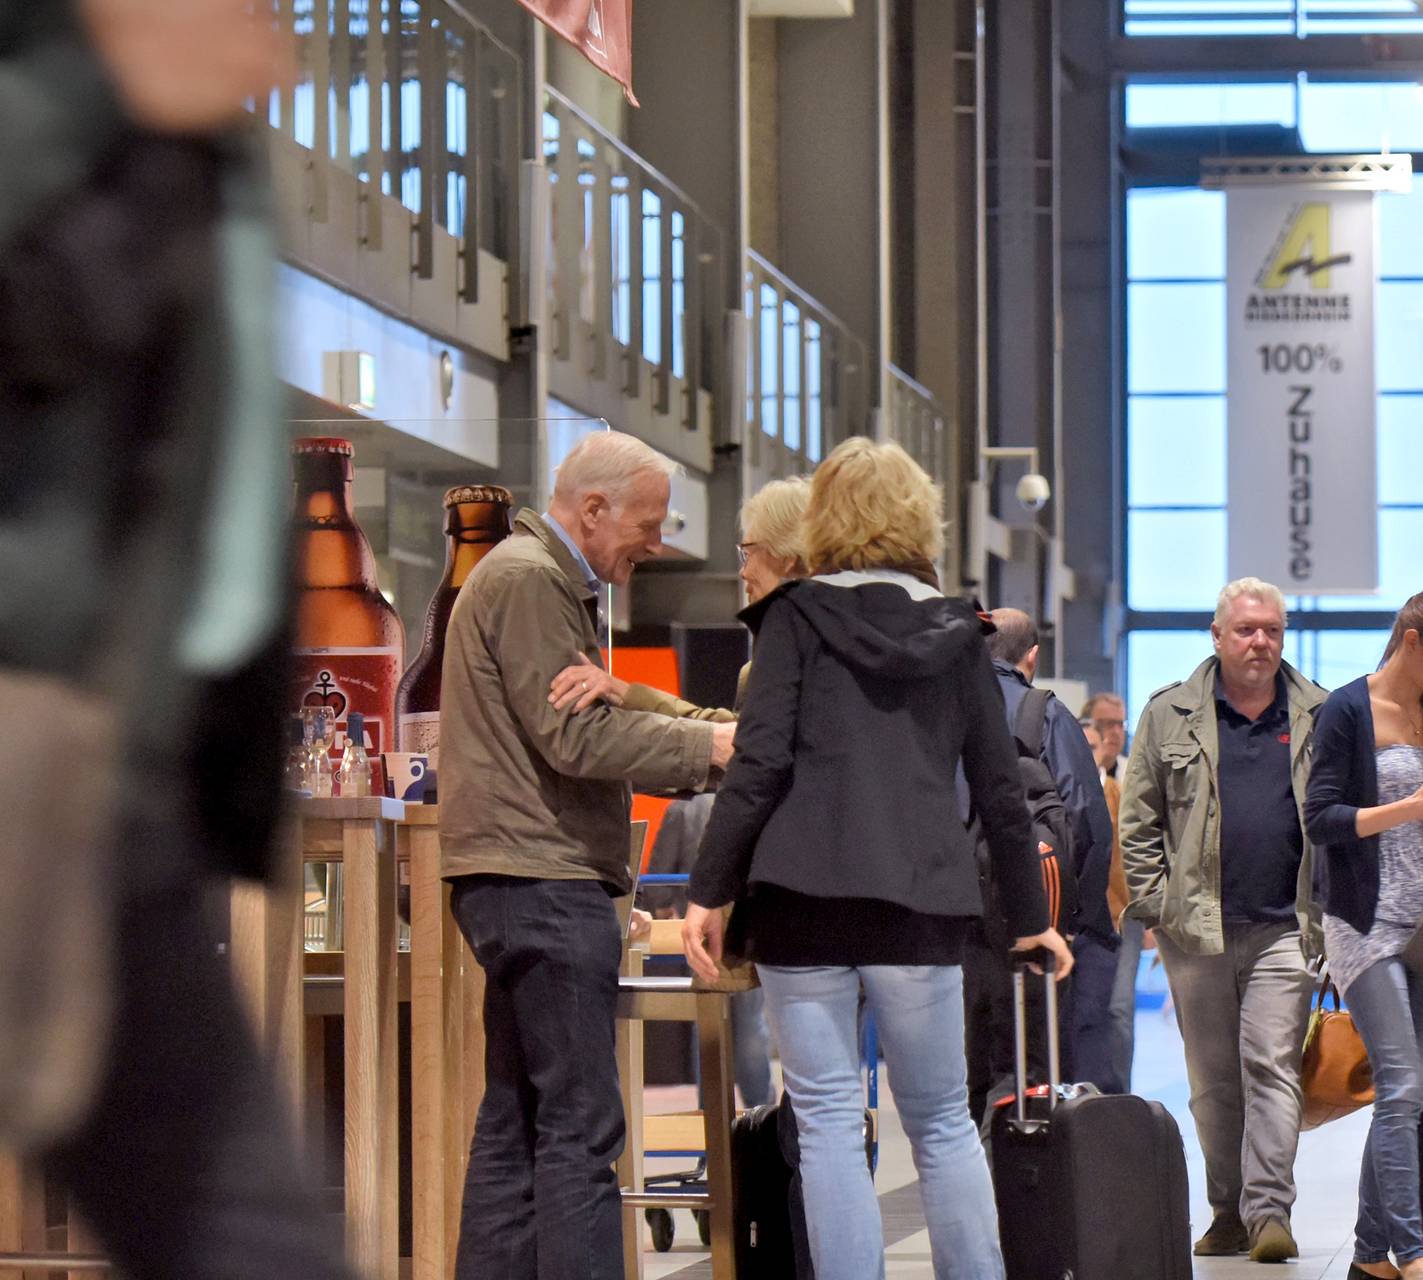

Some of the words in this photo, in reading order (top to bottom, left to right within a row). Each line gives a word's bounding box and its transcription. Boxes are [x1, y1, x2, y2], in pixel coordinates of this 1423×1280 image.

[1247, 294, 1351, 308] ANTENNE
[1258, 344, 1343, 374] 100%
[1286, 385, 1313, 581] Zuhause
